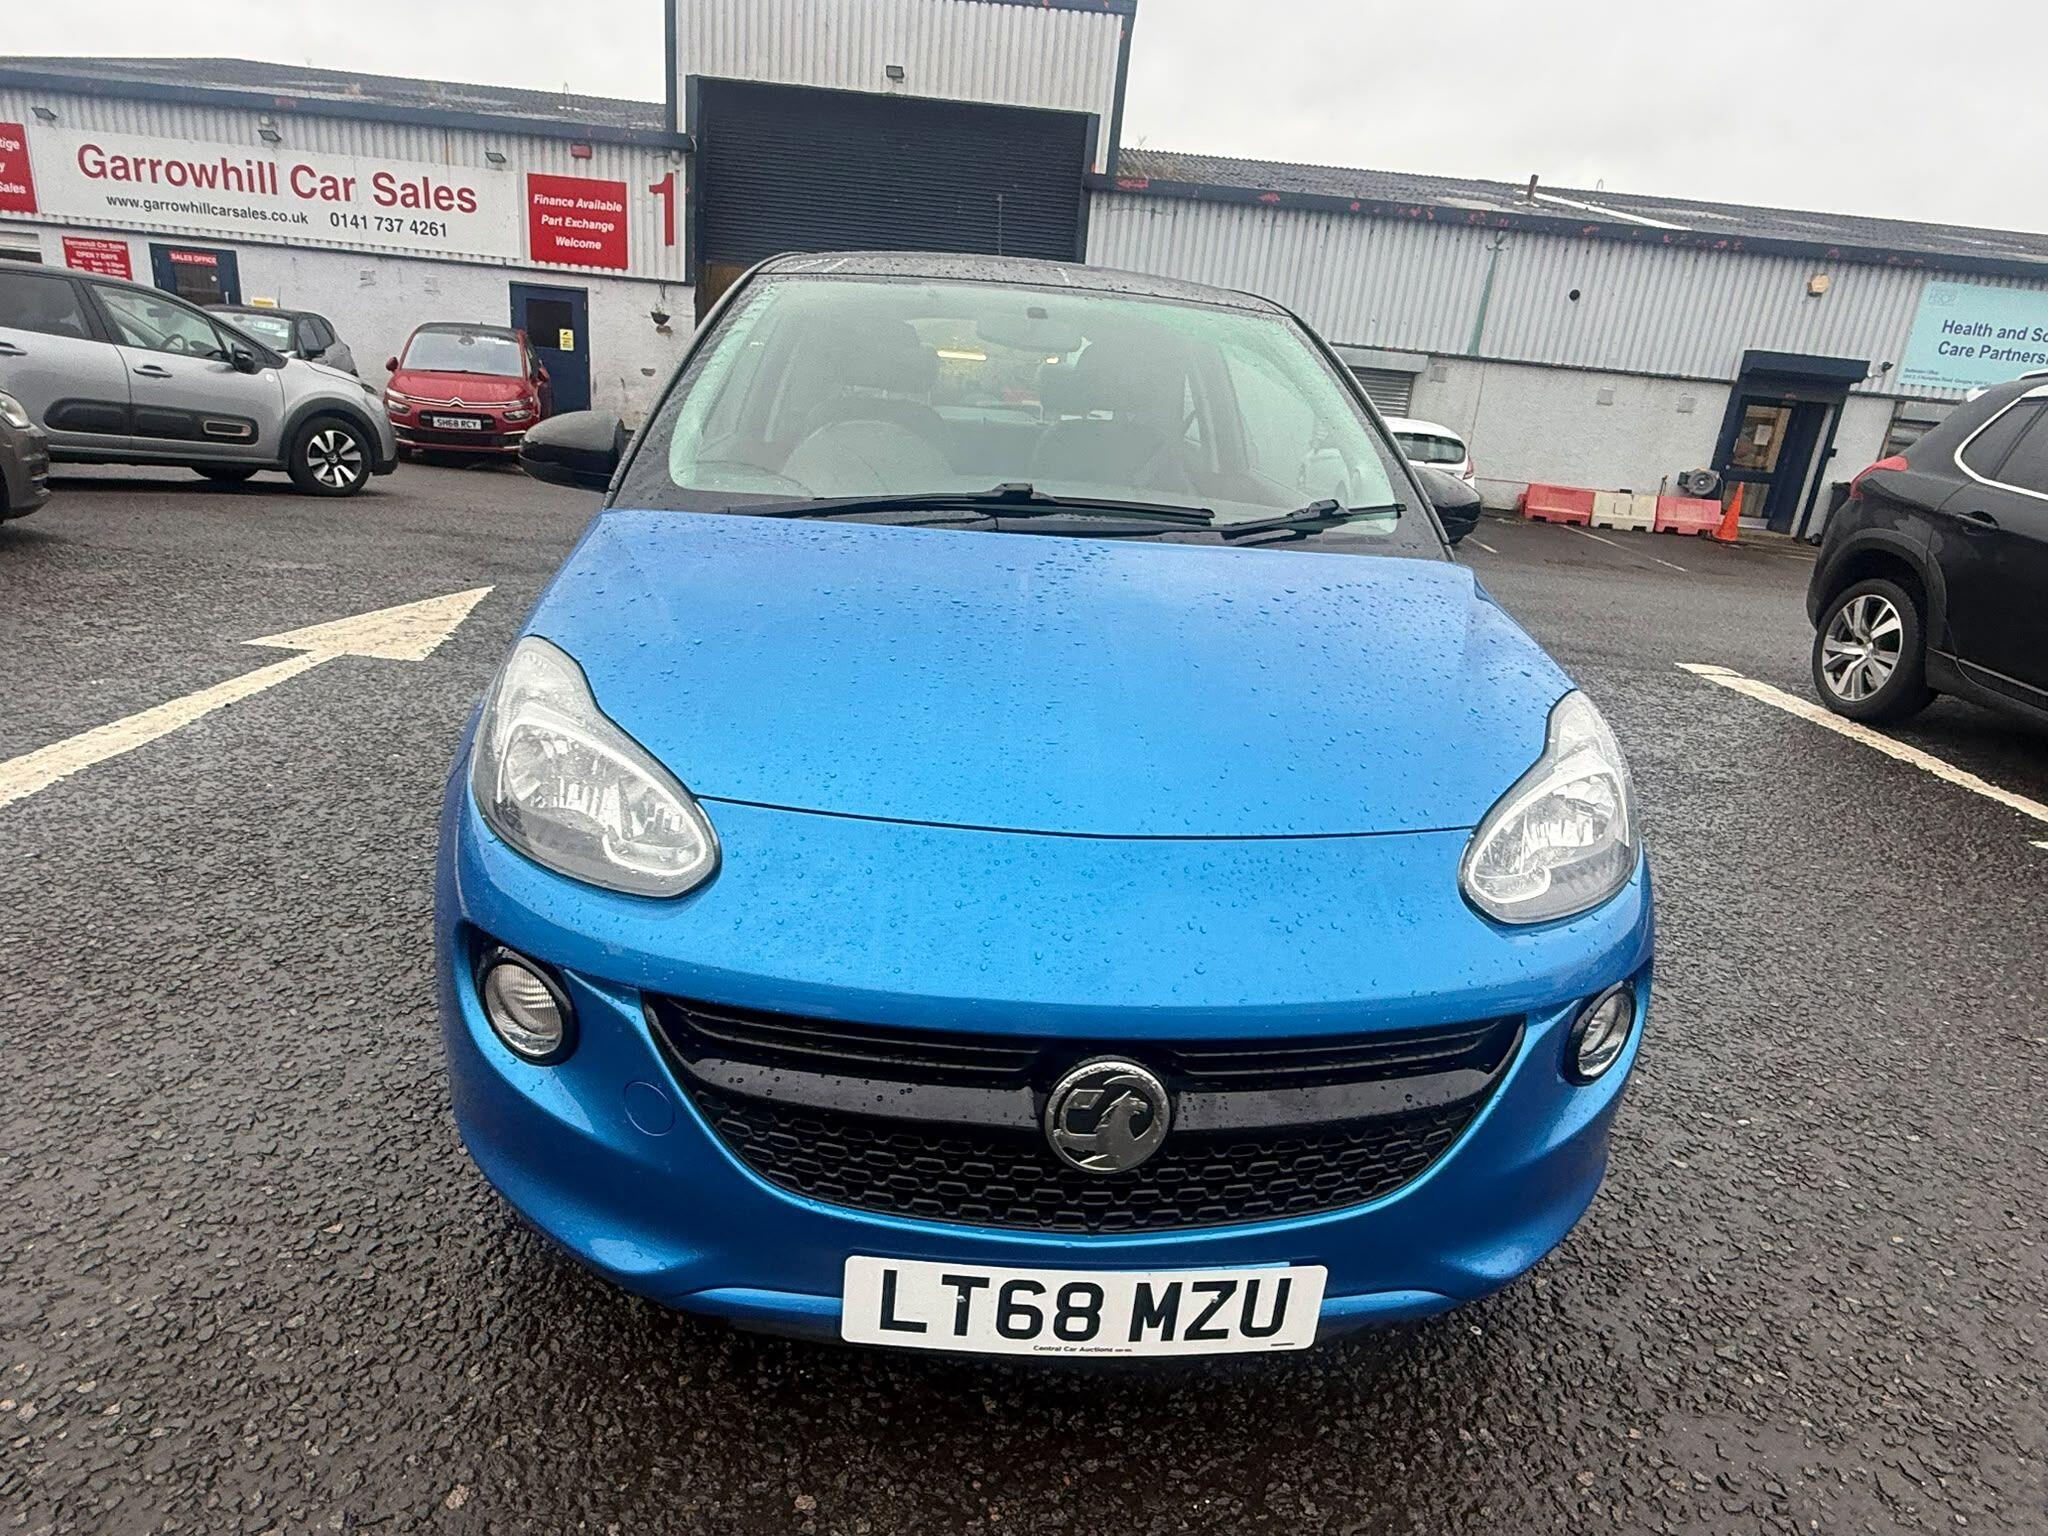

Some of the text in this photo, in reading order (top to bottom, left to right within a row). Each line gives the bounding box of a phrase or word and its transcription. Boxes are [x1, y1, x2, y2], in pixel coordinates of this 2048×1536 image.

[77, 143, 477, 214] Garrowhill Car Sales
[106, 195, 308, 225] www.garrowhillcarsales.co.uk
[533, 193, 623, 212] Finance Available
[649, 173, 675, 246] 1
[330, 212, 447, 237] 0141 737 4261
[541, 214, 615, 233] Part Exchange
[555, 235, 602, 250] Welcome
[170, 252, 217, 265] SALES OFFICE
[1941, 319, 1993, 338] Health
[1997, 327, 2029, 341] and
[1938, 341, 2048, 366] Care Partners
[879, 1269, 1293, 1343] LT68 MZU
